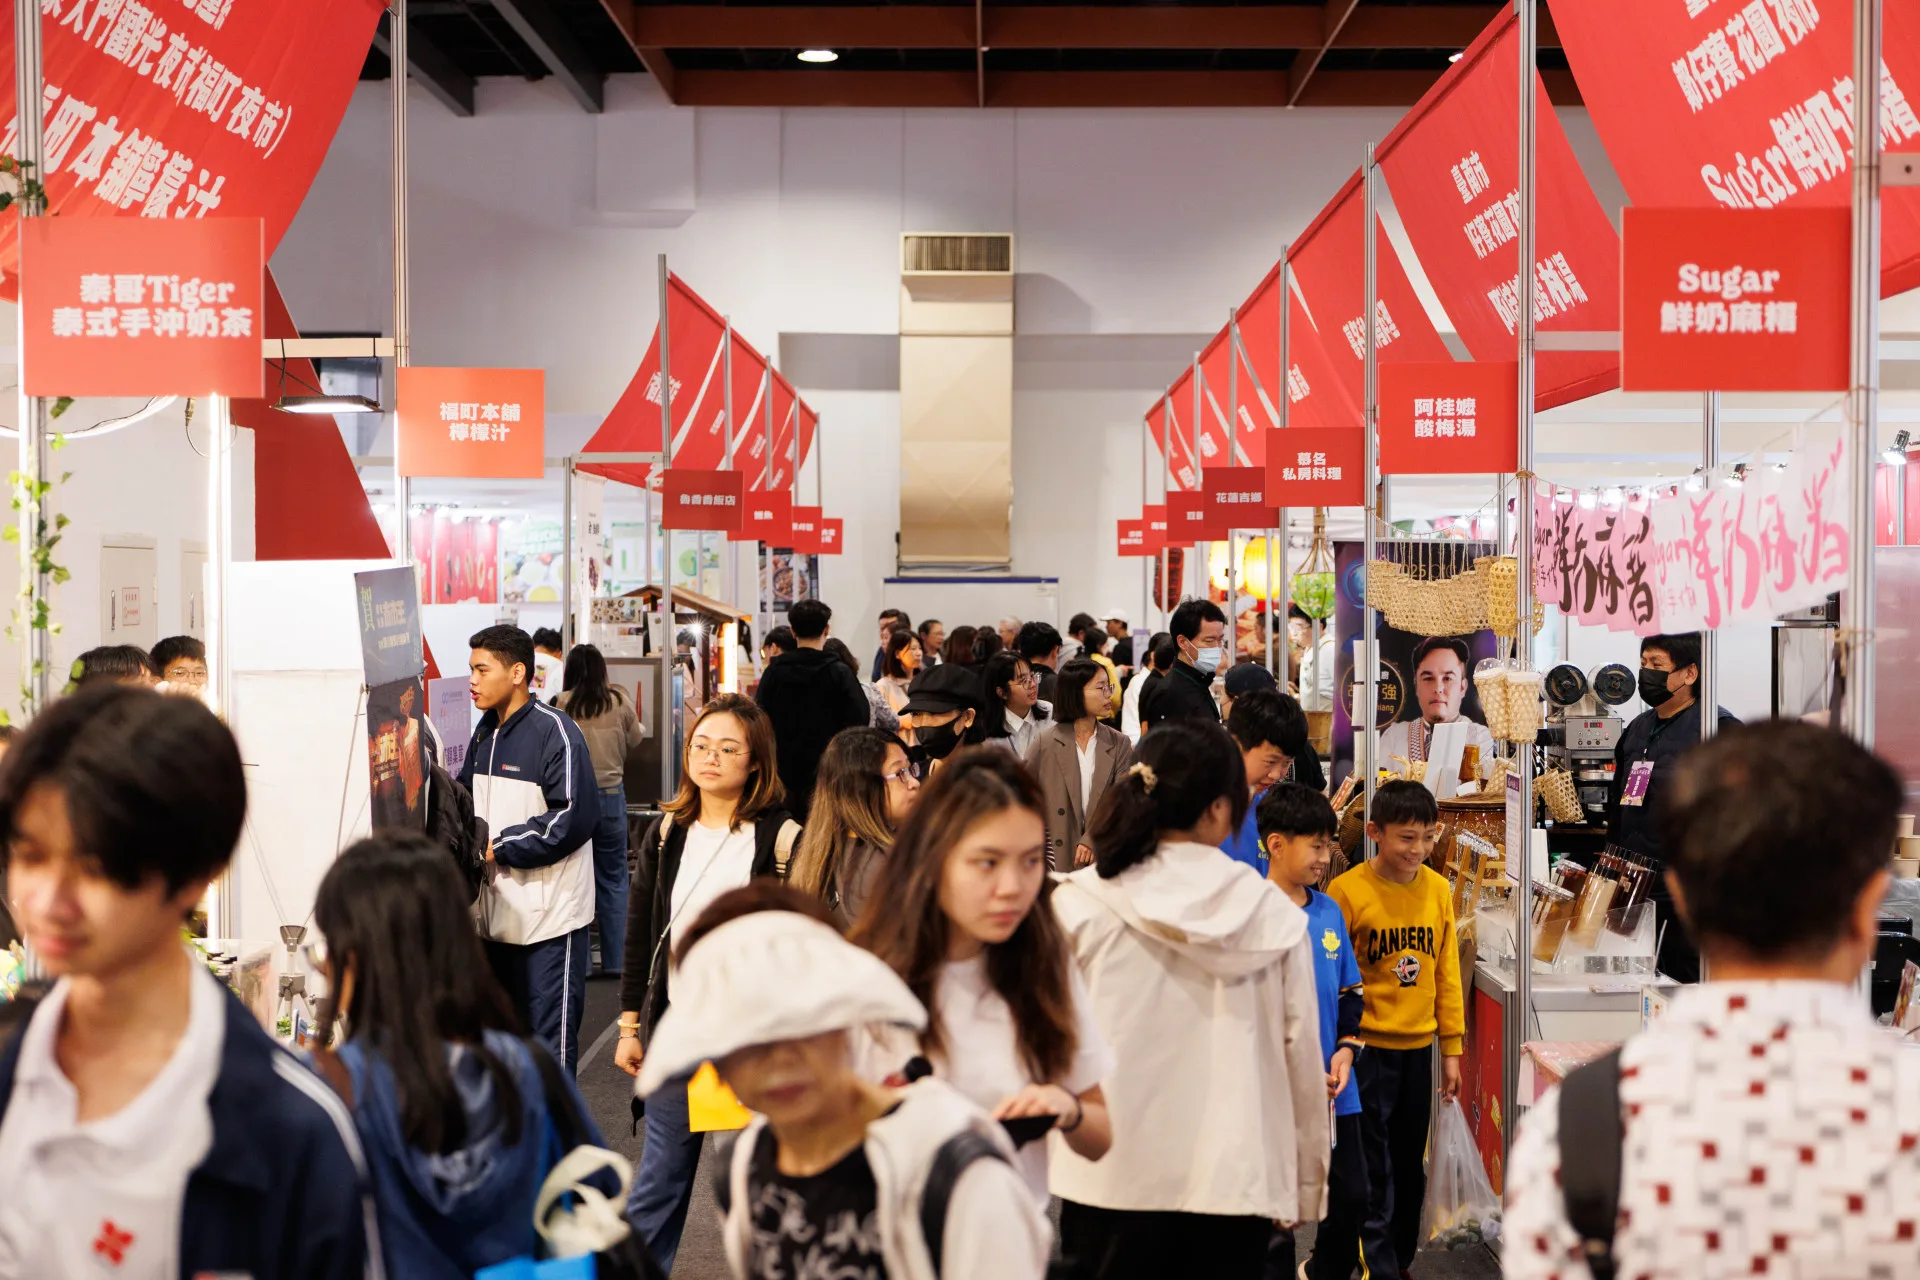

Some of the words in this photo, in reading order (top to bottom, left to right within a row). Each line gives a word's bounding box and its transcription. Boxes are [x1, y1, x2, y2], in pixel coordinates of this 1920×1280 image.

[1678, 263, 1780, 300] Sugar
[52, 307, 253, 338] 泰式手沖奶茶
[1414, 398, 1476, 417] 阿桂嬤
[449, 423, 510, 441] 檸檬汁
[1414, 419, 1476, 437] 酸梅湯
[1297, 452, 1326, 466] 慕名
[1282, 467, 1342, 480] 私房料理
[1367, 926, 1436, 965] CANBERR
